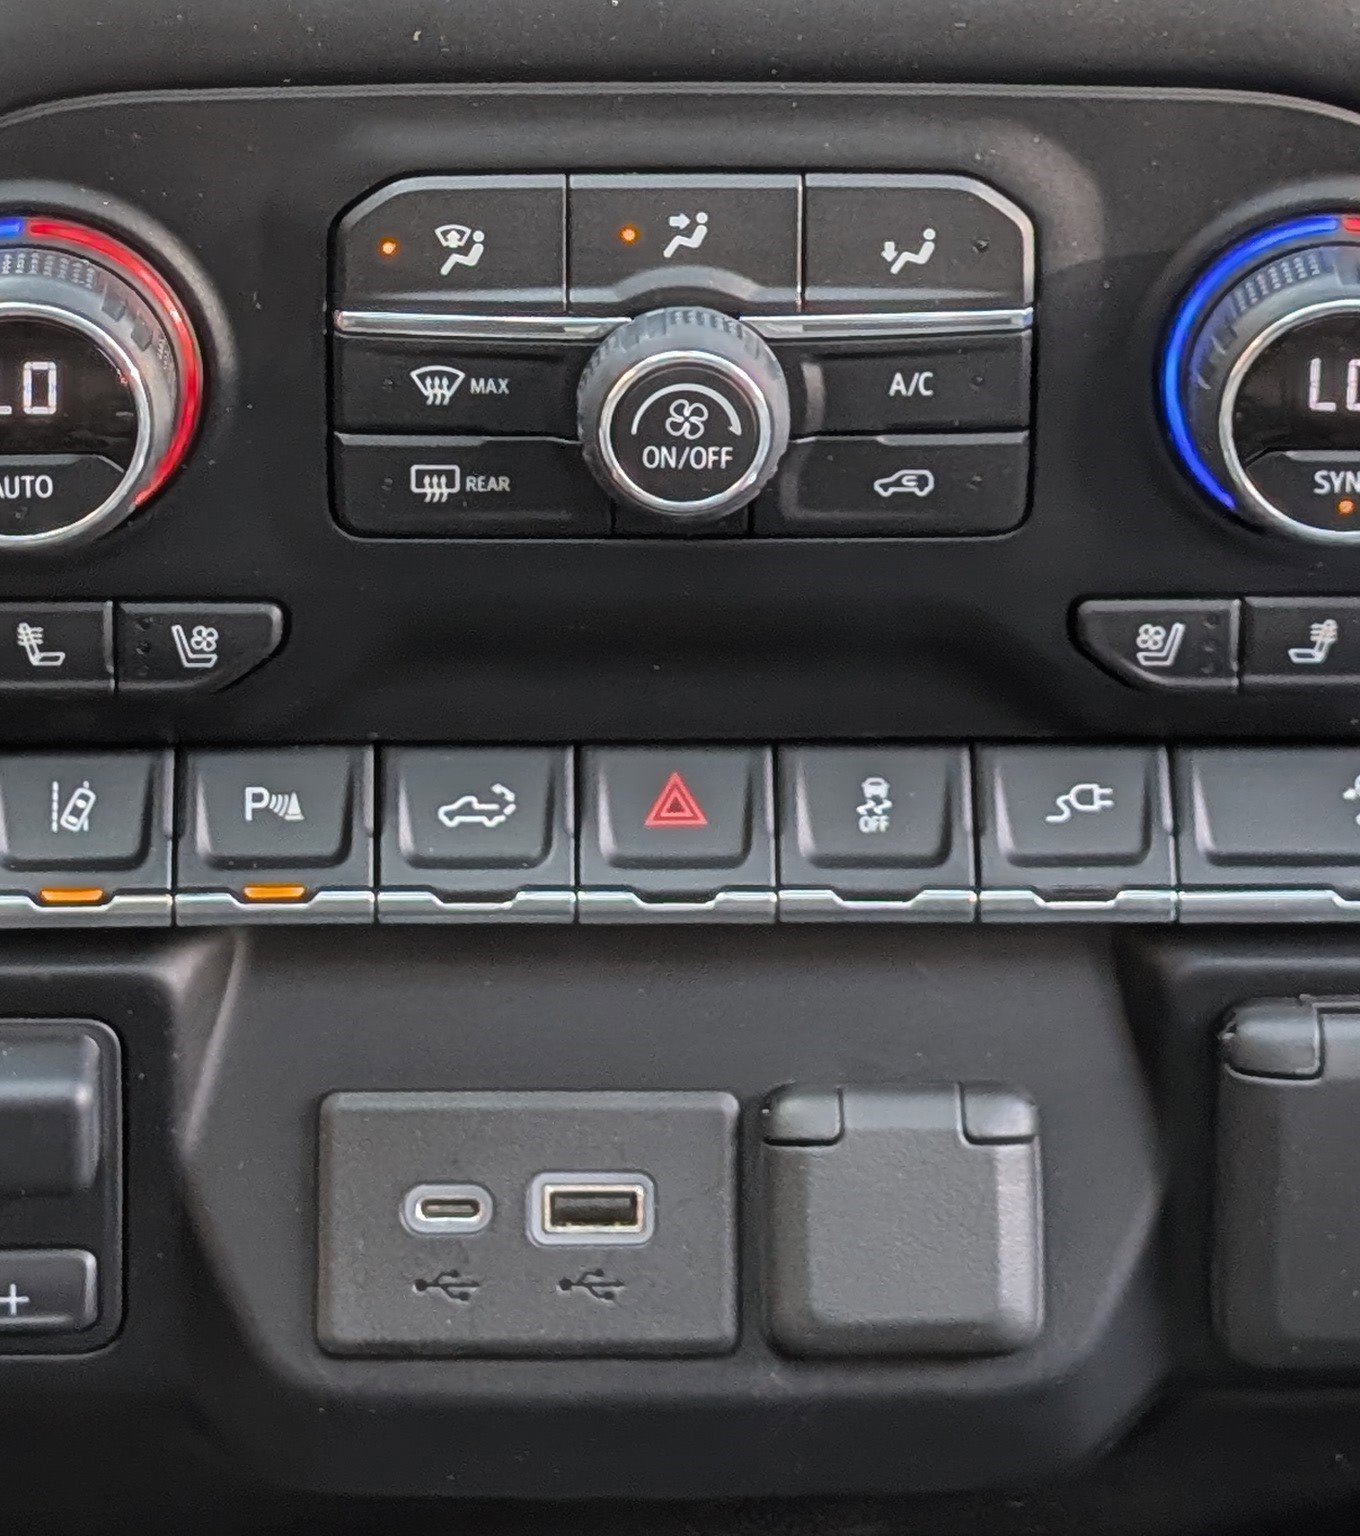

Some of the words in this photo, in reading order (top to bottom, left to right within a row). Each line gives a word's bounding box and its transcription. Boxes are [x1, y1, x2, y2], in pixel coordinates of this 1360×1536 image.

[469, 377, 509, 394] MAX
[888, 371, 934, 397] A/C
[642, 445, 733, 470] ON/OFF
[465, 475, 511, 493] REAR
[858, 814, 890, 834] OFF
